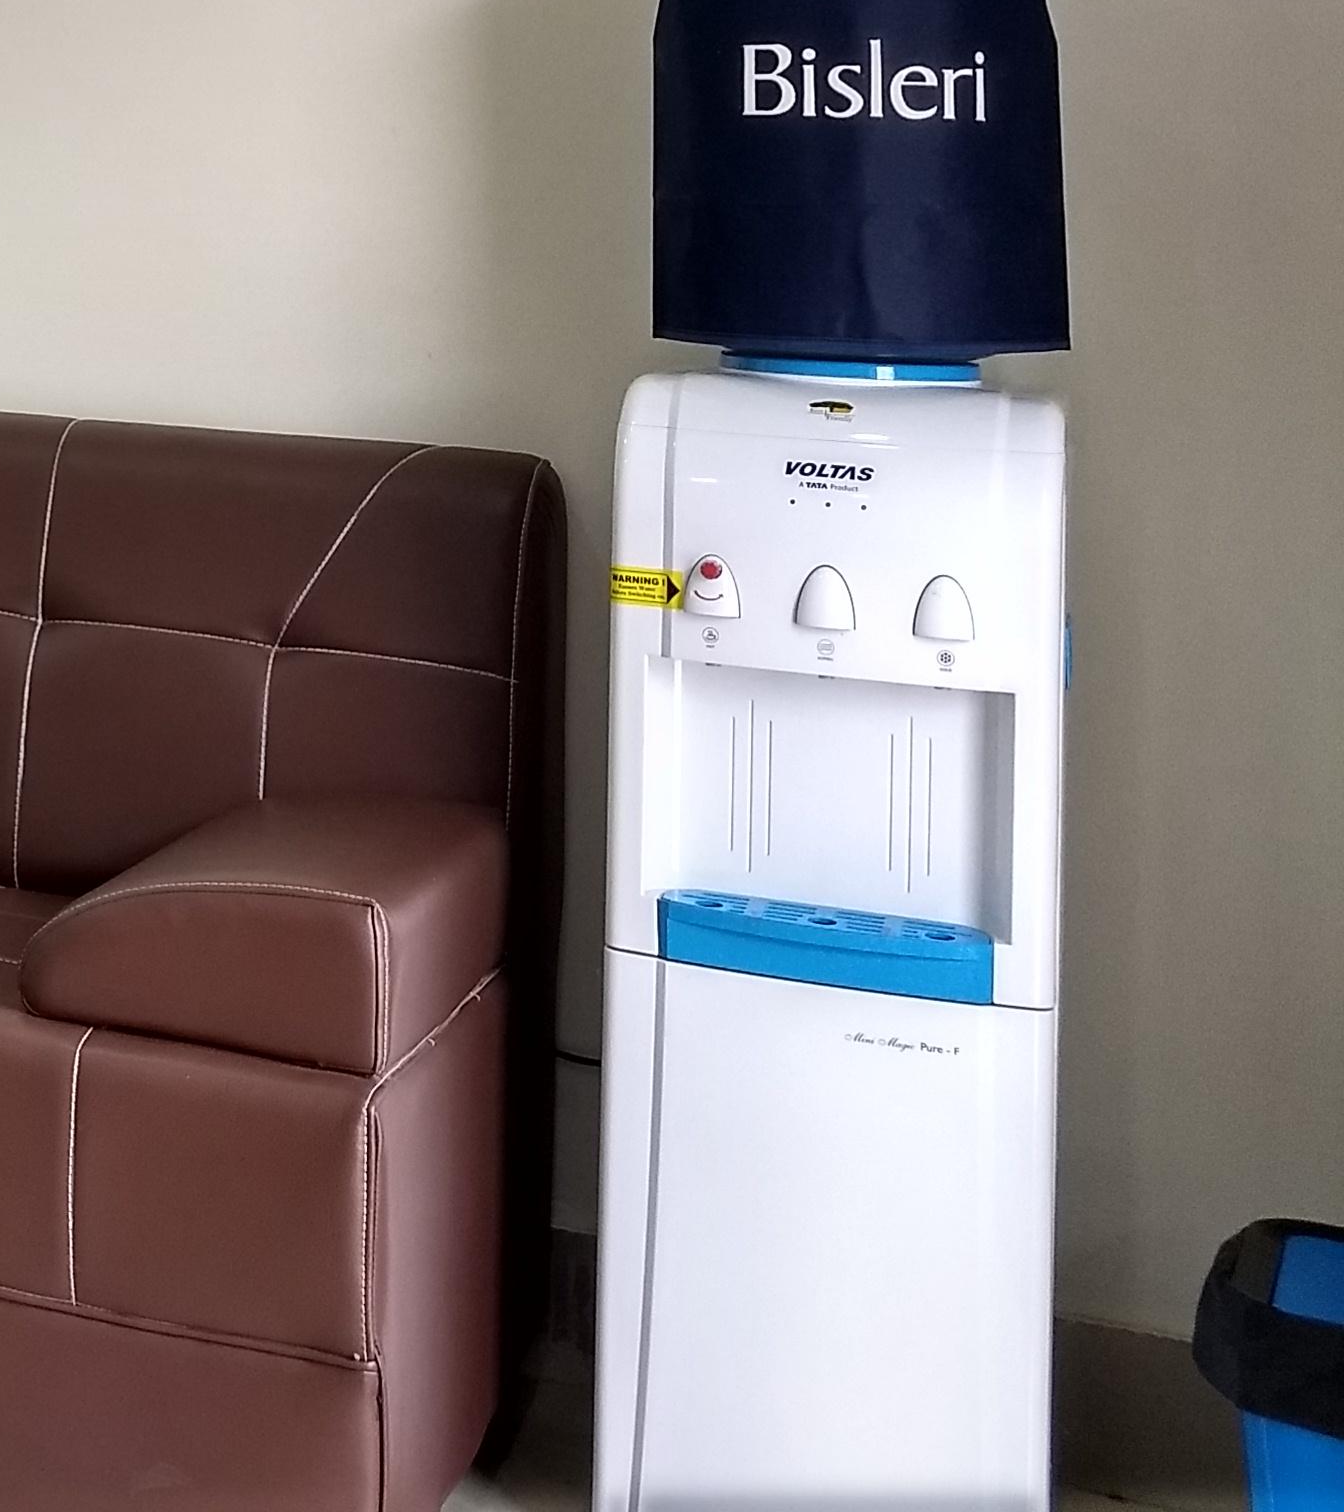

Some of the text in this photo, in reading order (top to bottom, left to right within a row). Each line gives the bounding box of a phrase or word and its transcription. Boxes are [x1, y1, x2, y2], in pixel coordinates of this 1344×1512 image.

[741, 38, 986, 122] Bisleri
[785, 461, 875, 481] VOLTAS
[806, 482, 828, 490] TATA
[920, 1042, 943, 1054] Pure
